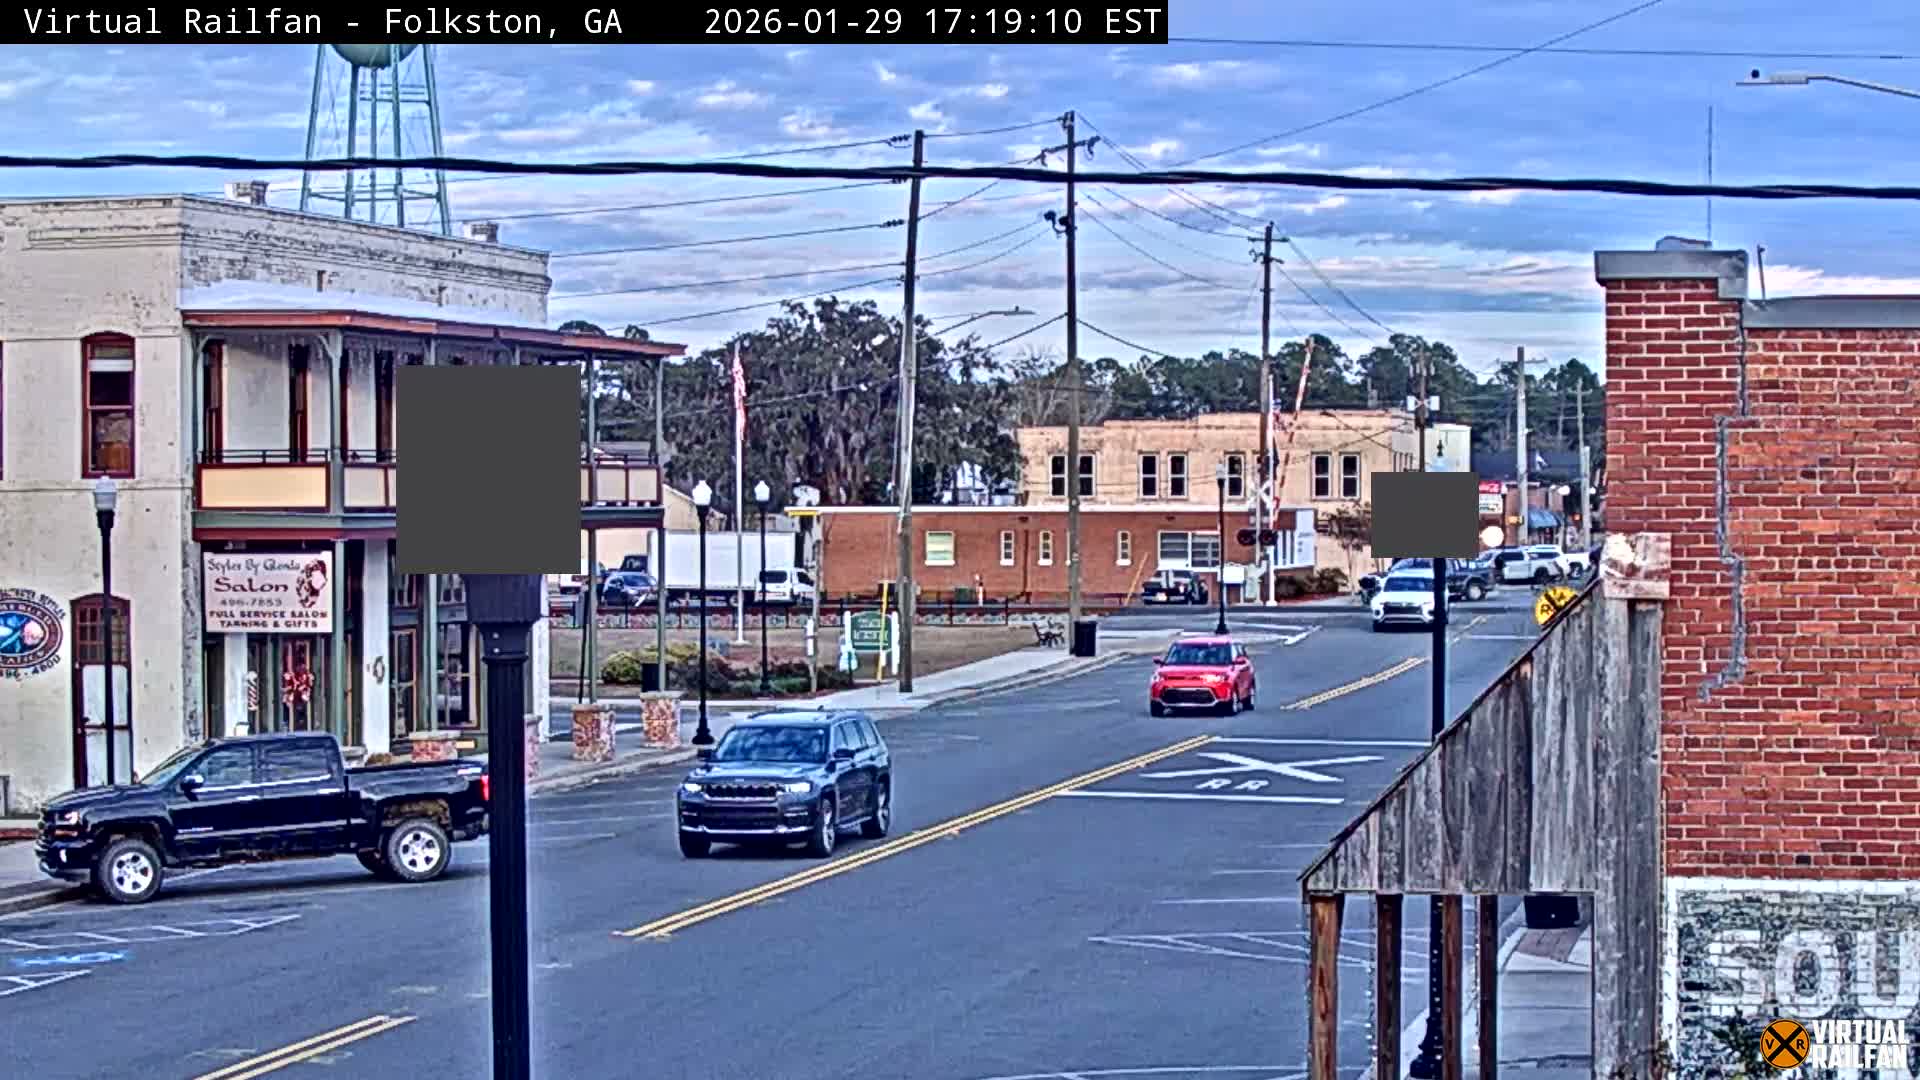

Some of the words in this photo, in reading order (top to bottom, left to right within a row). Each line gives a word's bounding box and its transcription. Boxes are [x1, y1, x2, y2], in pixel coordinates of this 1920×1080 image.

[214, 576, 289, 592] Salon
[209, 610, 235, 618] FULL
[240, 610, 285, 618] SERVICE
[290, 610, 328, 618] SALON
[284, 620, 318, 628] GIFTS
